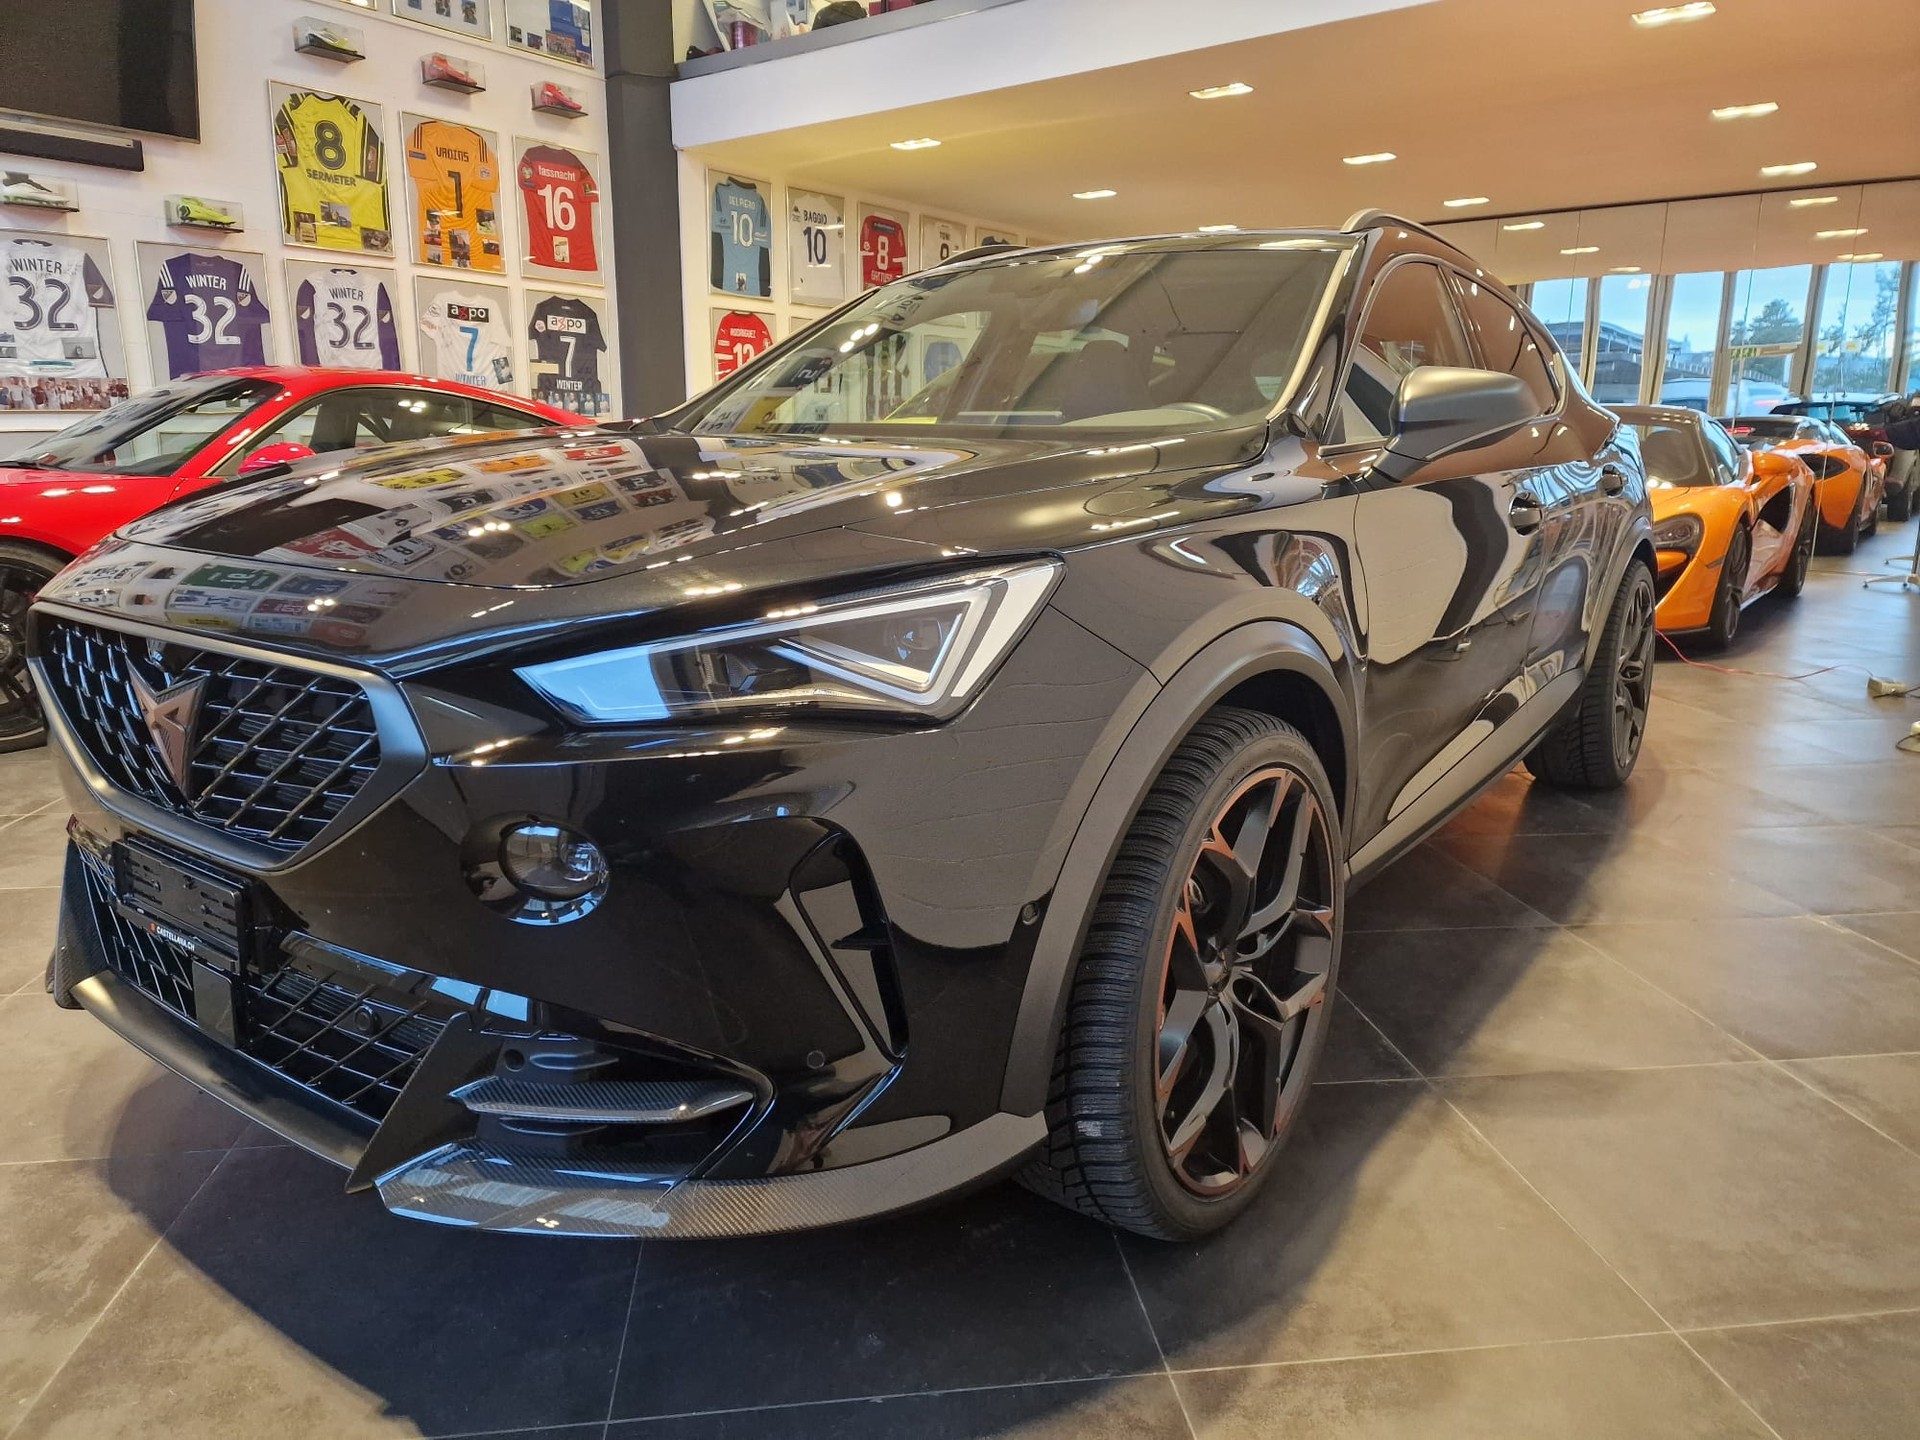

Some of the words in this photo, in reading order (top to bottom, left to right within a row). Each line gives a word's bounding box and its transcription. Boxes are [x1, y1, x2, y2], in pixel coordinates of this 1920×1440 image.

[314, 119, 347, 171] 8
[306, 168, 357, 187] SERMETER
[447, 170, 464, 219] 1
[537, 184, 576, 231] 16
[803, 210, 828, 225] BAGGIO
[730, 211, 753, 247] 10
[803, 226, 826, 265] 10
[10, 258, 62, 275] WINTER
[877, 235, 889, 271] 8
[185, 274, 227, 291] WINTER
[328, 287, 364, 302] WINTER
[8, 276, 79, 331] 32
[184, 294, 241, 345] 32
[327, 302, 376, 350] 32
[459, 326, 479, 372] 7
[559, 335, 577, 378] 7
[455, 373, 487, 386] WINTER
[556, 379, 583, 391] WINTER
